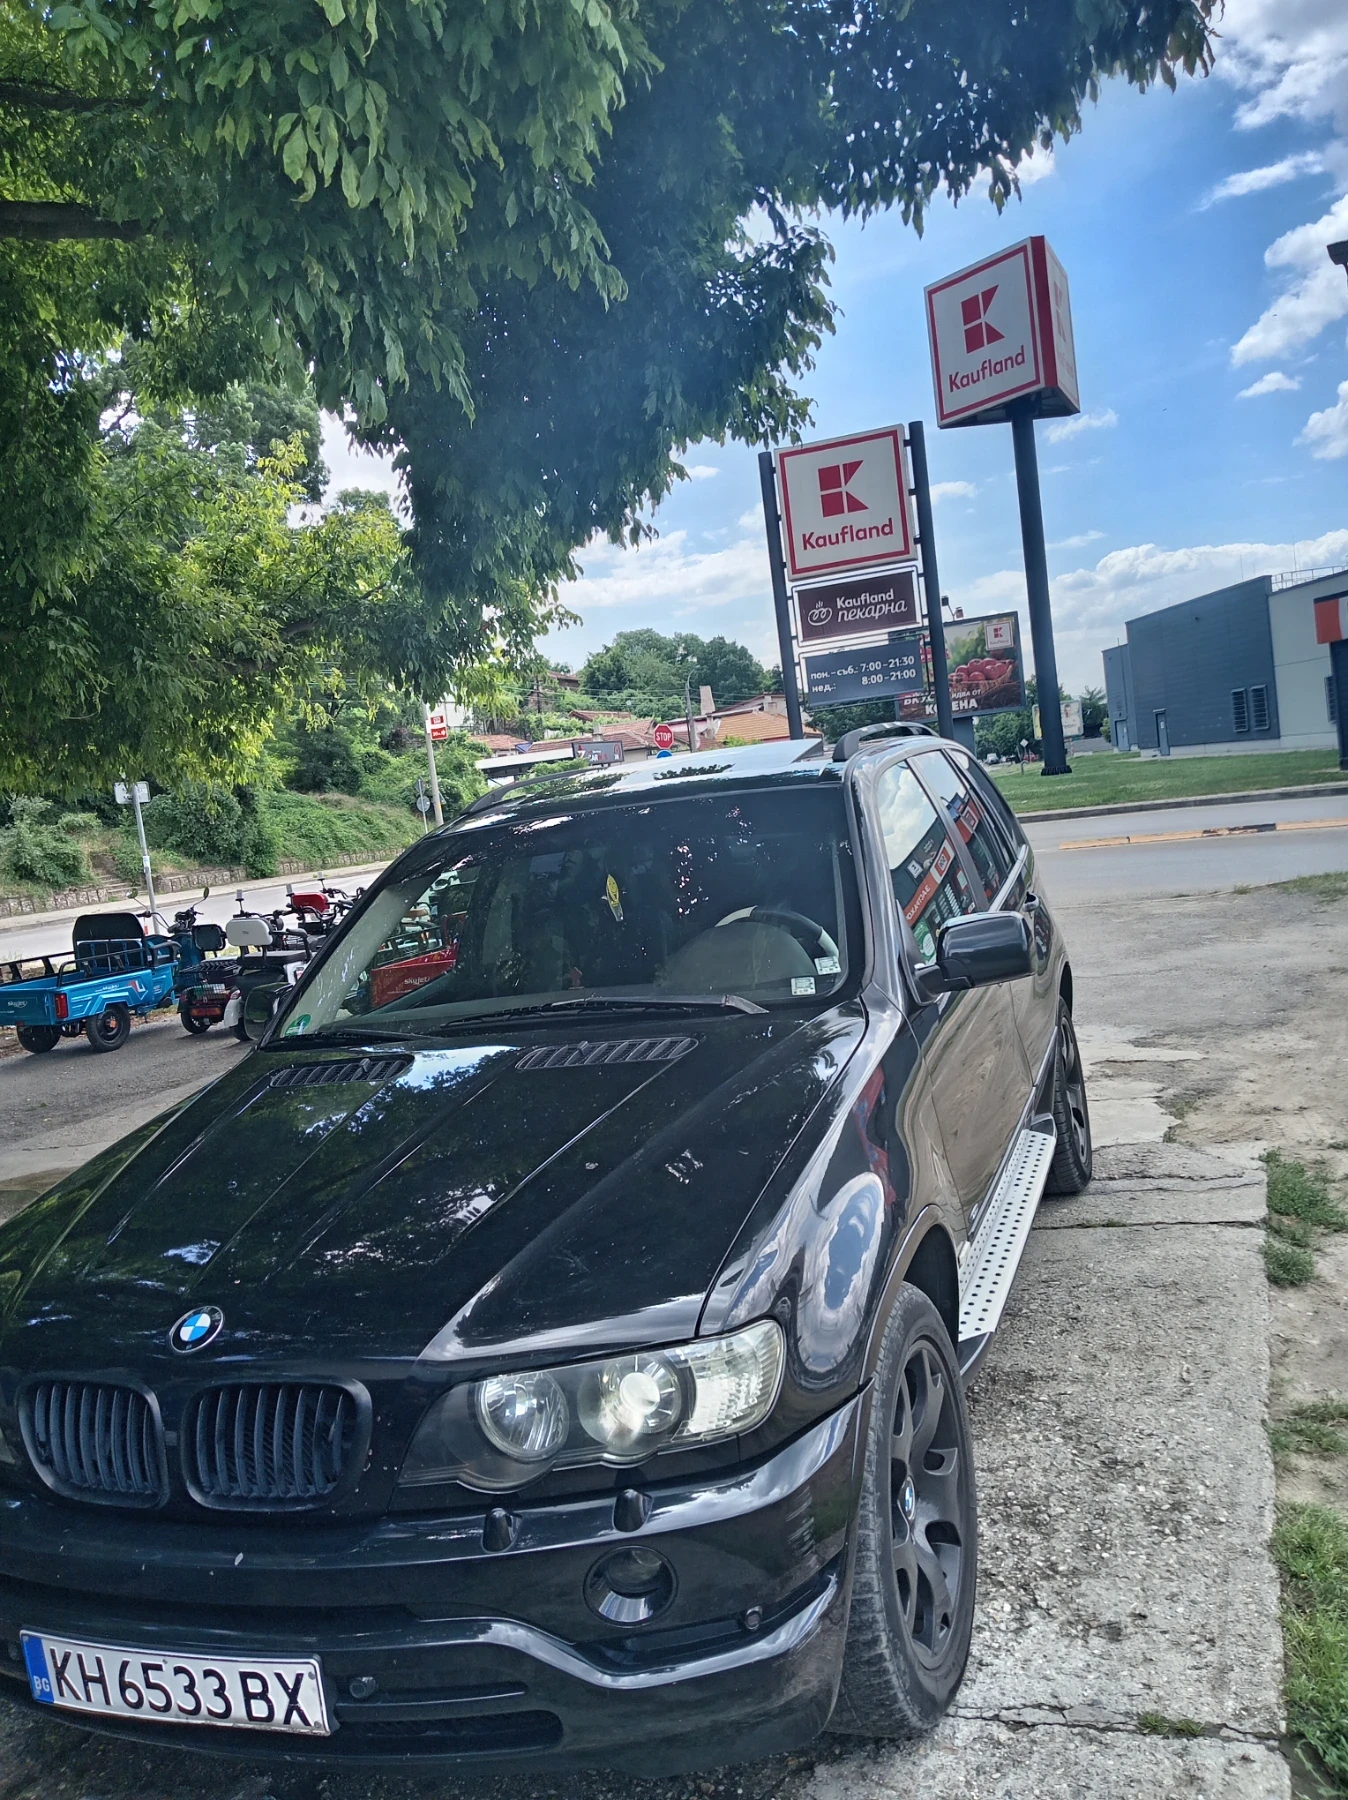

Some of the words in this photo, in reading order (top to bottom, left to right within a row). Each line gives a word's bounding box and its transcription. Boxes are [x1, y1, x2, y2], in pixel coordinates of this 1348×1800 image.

[949, 345, 1025, 393] Kaufland
[802, 518, 894, 551] Kaufland
[836, 589, 894, 609] Kaufland
[838, 600, 908, 622] пекарна
[812, 683, 836, 694] нед.:
[656, 732, 672, 742] STOP
[33, 1675, 51, 1693] BG
